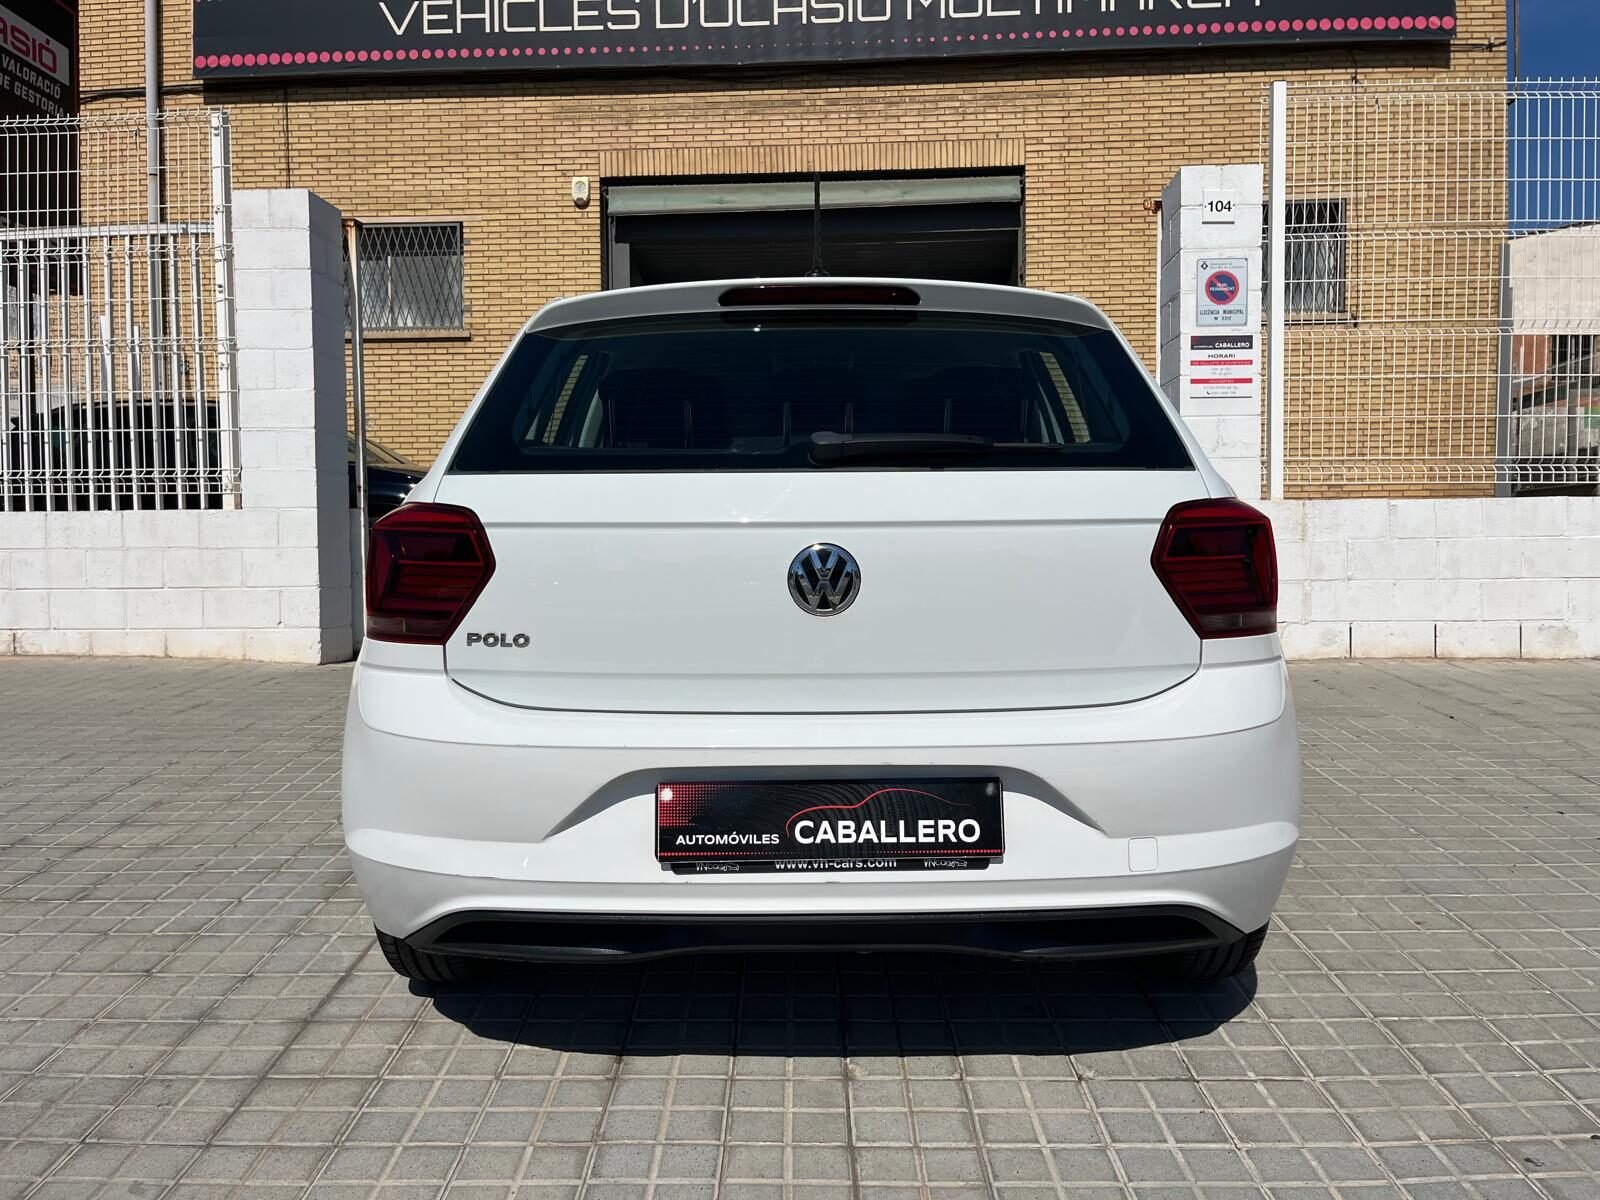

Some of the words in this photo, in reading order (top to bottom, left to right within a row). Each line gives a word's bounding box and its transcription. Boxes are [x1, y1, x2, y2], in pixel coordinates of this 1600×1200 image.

[379, 0, 641, 36] VEHICLES
[1, 53, 61, 100] VALORACIÓ
[1207, 200, 1232, 212] 104
[466, 632, 531, 648] POLO
[675, 831, 780, 846] AUTOMÓVILES
[794, 818, 981, 845] CABALLERO
